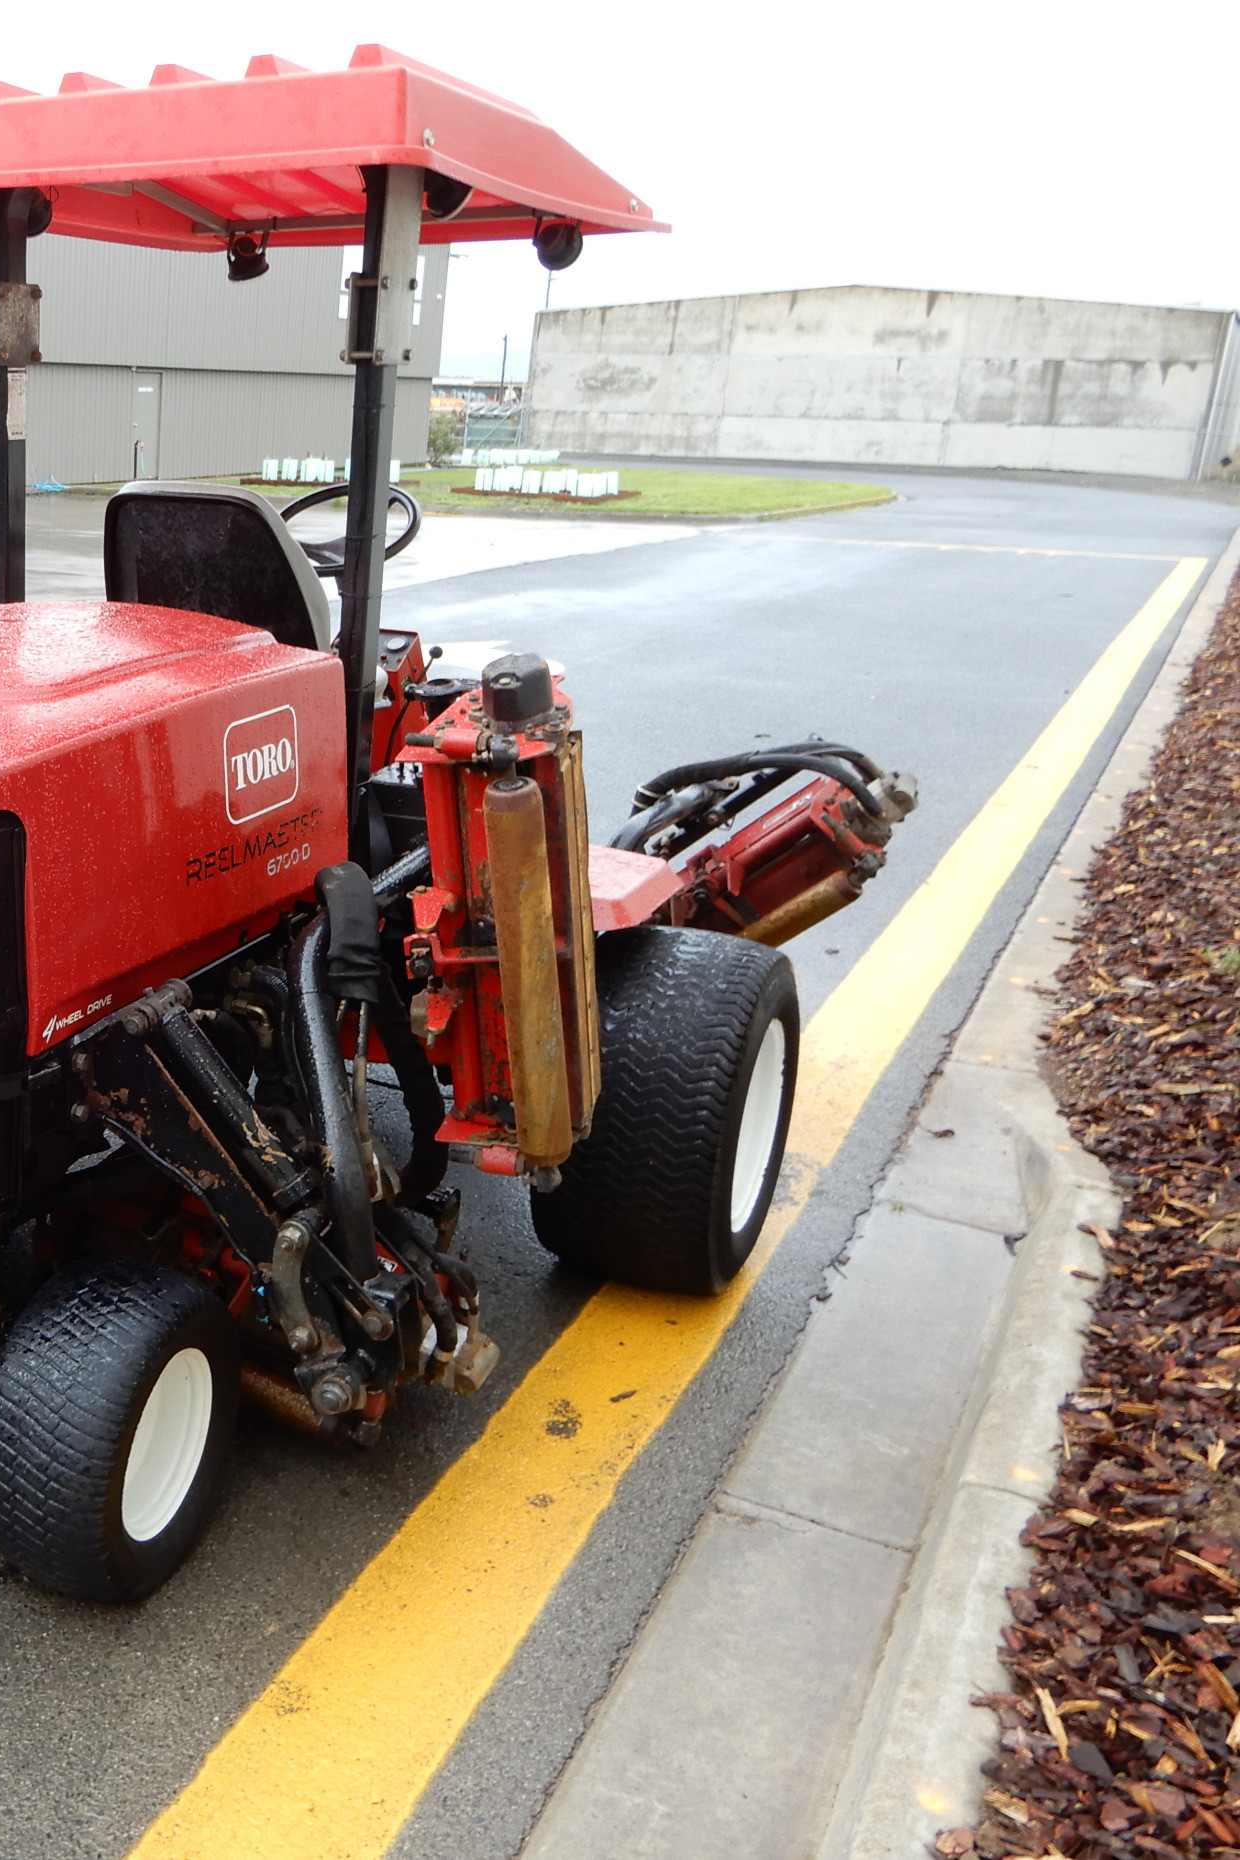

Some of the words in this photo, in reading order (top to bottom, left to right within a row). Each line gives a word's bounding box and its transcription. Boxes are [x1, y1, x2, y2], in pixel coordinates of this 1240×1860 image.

[231, 738, 295, 791] TORO
[42, 1014, 57, 1044] 4
[56, 1010, 84, 1031] WHEEL
[86, 994, 113, 1015] DRIVE
